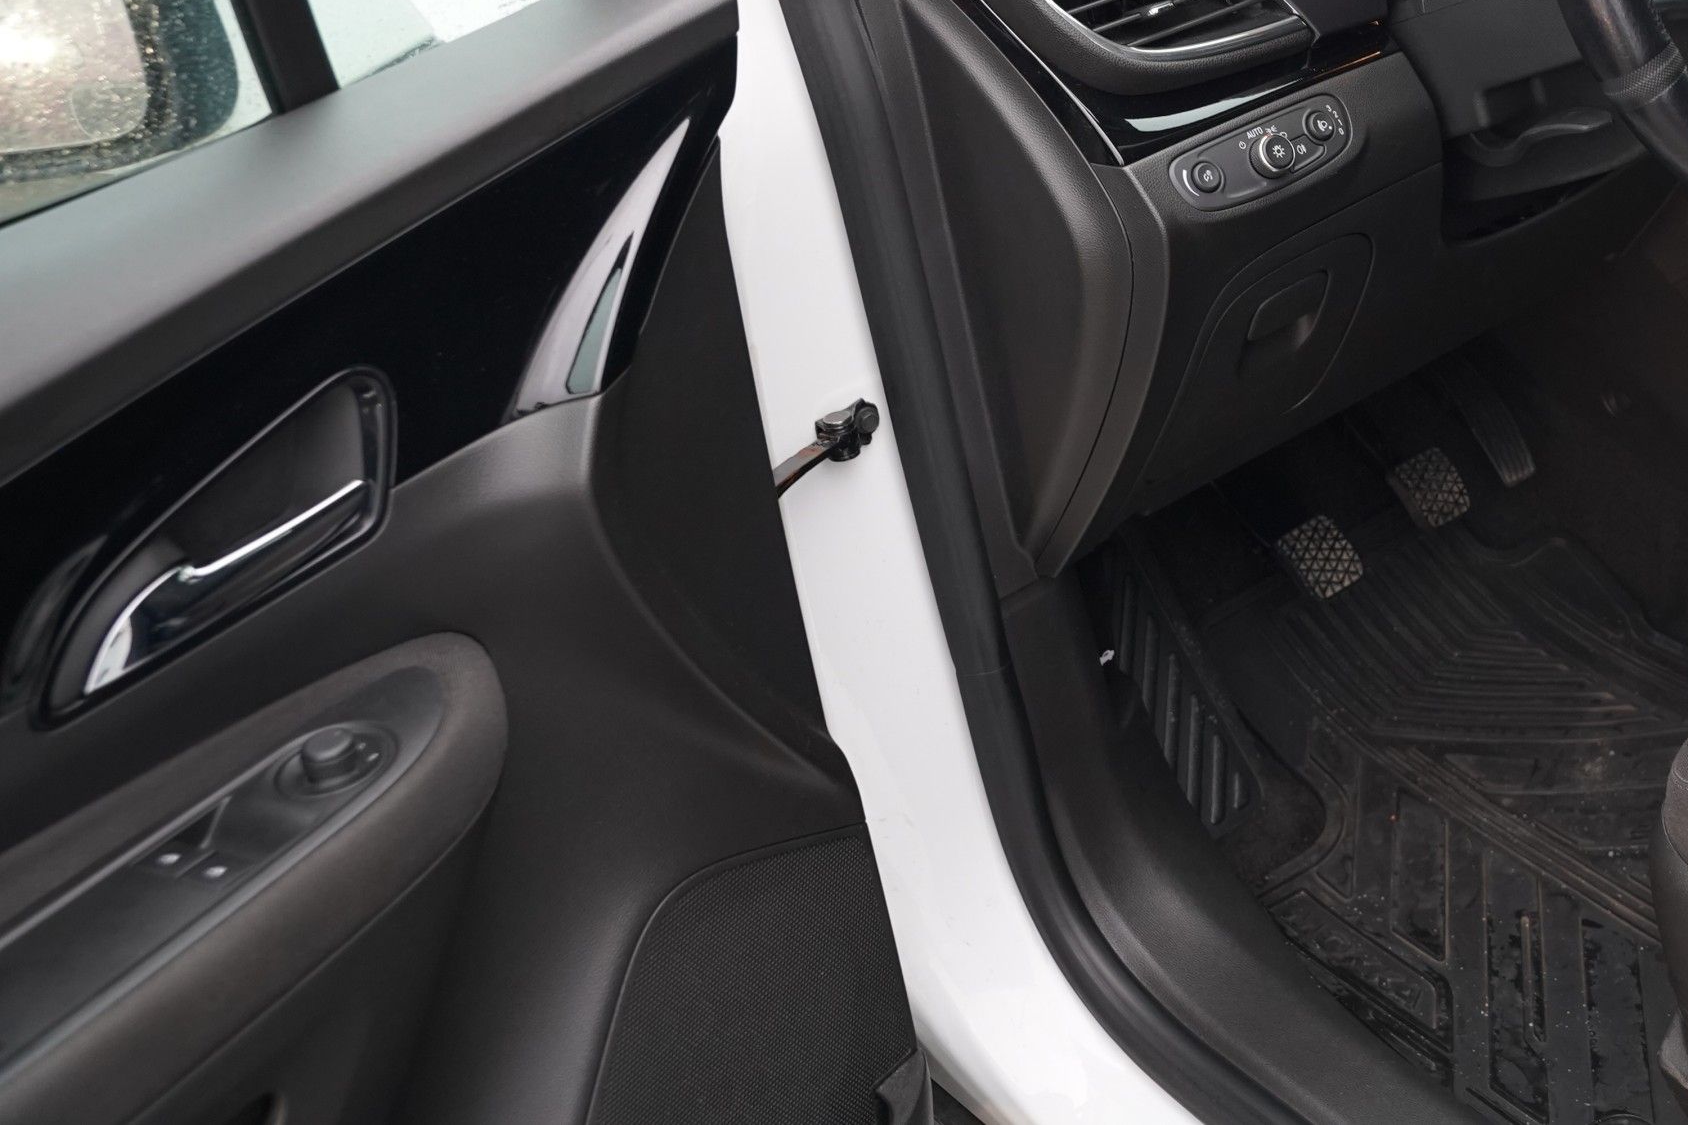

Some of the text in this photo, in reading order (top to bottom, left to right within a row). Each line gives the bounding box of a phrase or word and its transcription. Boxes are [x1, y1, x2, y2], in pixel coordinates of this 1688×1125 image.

[1332, 110, 1339, 118] 2
[1246, 126, 1264, 139] AUTO
[1338, 127, 1345, 136] 0
